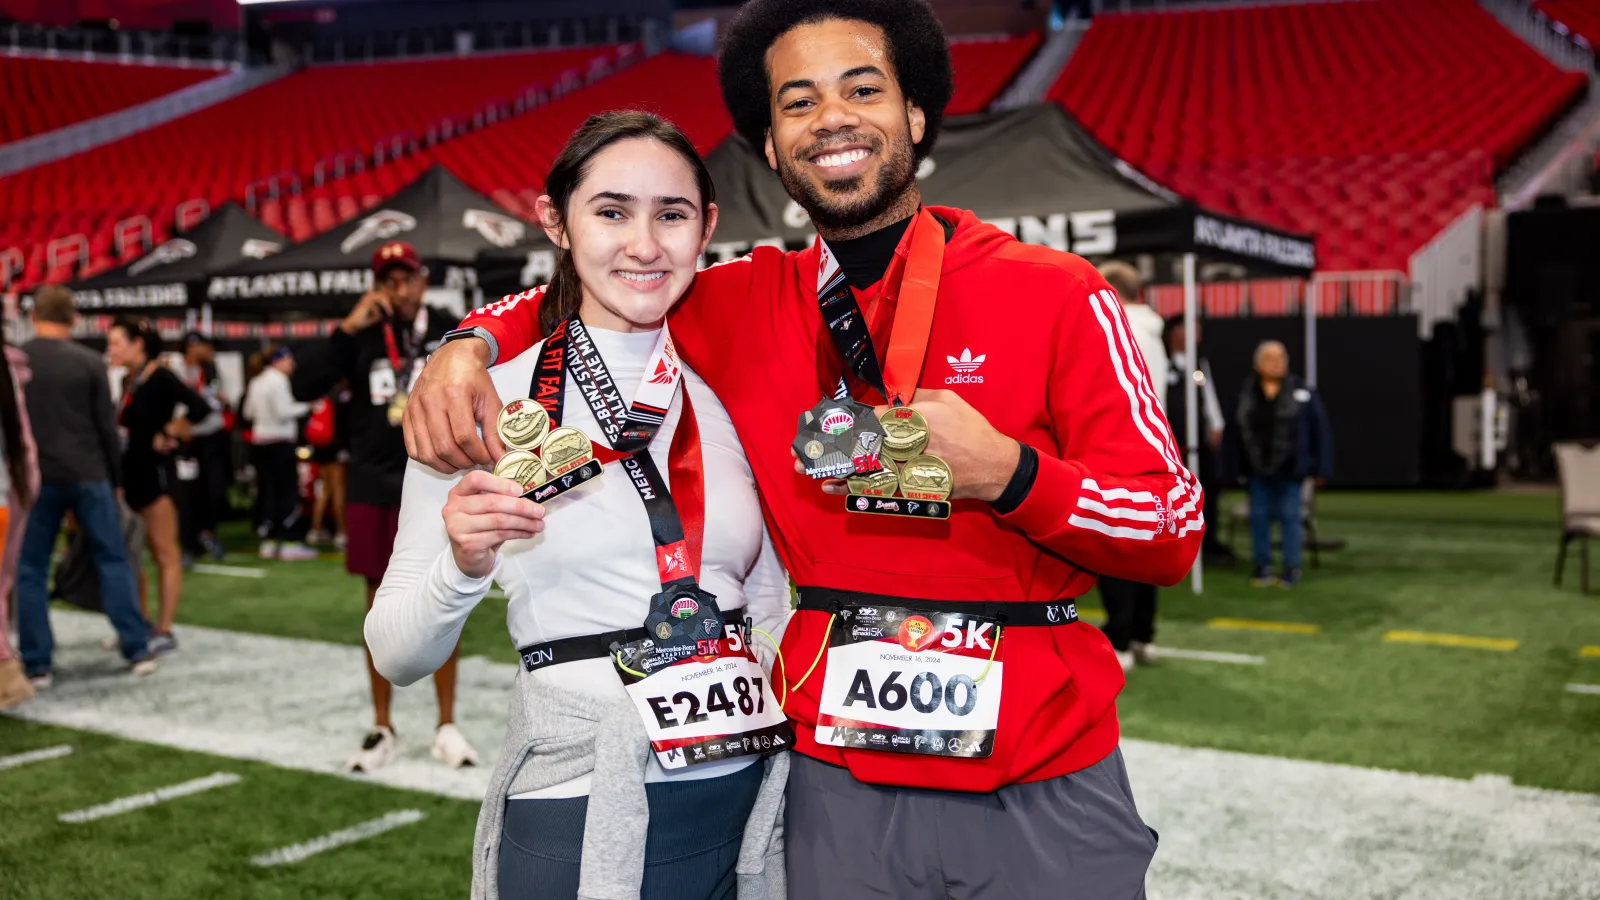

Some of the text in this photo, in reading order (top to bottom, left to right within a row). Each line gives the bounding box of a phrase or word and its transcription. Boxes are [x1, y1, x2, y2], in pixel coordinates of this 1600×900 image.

[207, 272, 317, 298] ATLANTA
[542, 348, 563, 371] FIT
[569, 319, 628, 429] ALK LIKE MADD
[944, 374, 984, 384] adidas
[805, 462, 852, 475] Mercedes-Benz
[853, 452, 882, 473] 5K
[813, 469, 847, 479] STADIUM
[1153, 495, 1167, 534] adidas
[941, 617, 994, 650] 5K
[655, 645, 696, 654] Mercedes-Benz
[697, 638, 719, 656] 5K
[880, 653, 912, 661] NOVEMBER
[925, 656, 941, 664] 2024
[681, 668, 714, 682] NOVEMBER
[724, 662, 737, 671] 2024
[646, 675, 765, 729] E2487
[842, 668, 978, 716] A600
